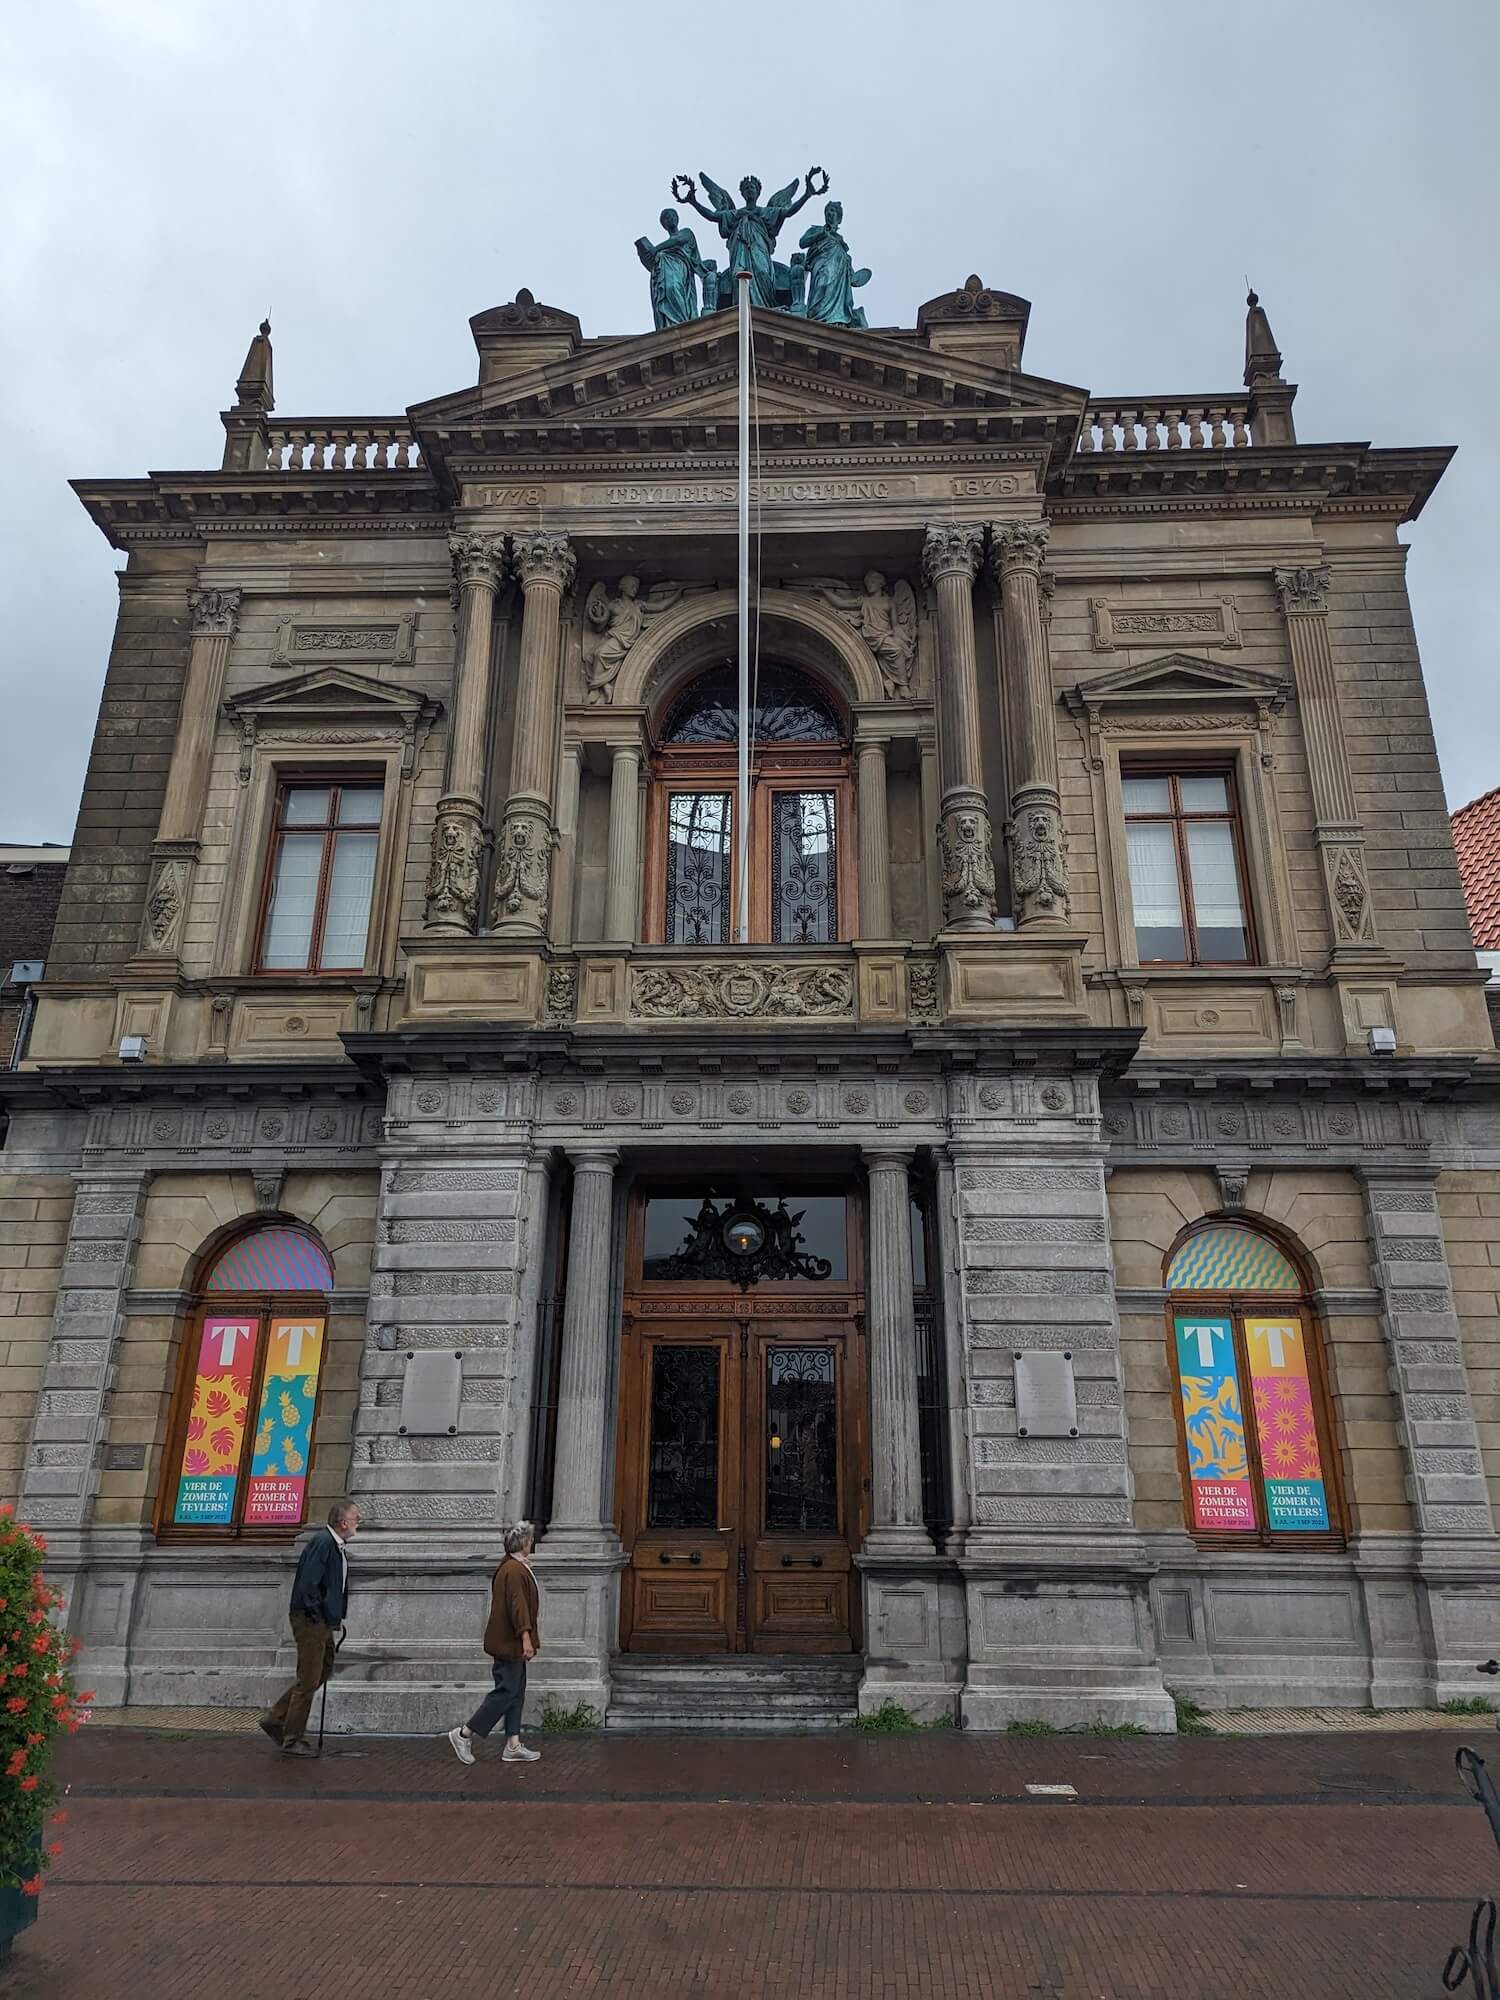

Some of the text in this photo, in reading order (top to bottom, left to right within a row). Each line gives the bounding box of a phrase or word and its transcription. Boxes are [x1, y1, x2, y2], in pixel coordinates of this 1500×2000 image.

[749, 482, 889, 501] STICHTING
[953, 478, 1013, 496] 1878
[483, 488, 538, 506] 1778
[210, 1326, 250, 1366] T
[277, 1326, 317, 1366] T
[1183, 1326, 1225, 1368] T
[1253, 1327, 1295, 1368] T
[185, 1482, 222, 1491] VIER DE
[254, 1482, 292, 1491] VIER DE
[1197, 1486, 1237, 1496] VIER DE
[1270, 1485, 1311, 1495] VIER DE
[182, 1492, 229, 1501] ZOMER IN
[252, 1492, 299, 1501] ZOMER IN
[1198, 1497, 1248, 1506] ZOMER IN
[1271, 1496, 1321, 1506] ZOMER IN
[181, 1503, 228, 1512] TEYLERS!
[251, 1503, 298, 1512] TEYLERS!
[1200, 1507, 1249, 1517] TEYLERS!
[1272, 1506, 1323, 1517] TEYLERS!
